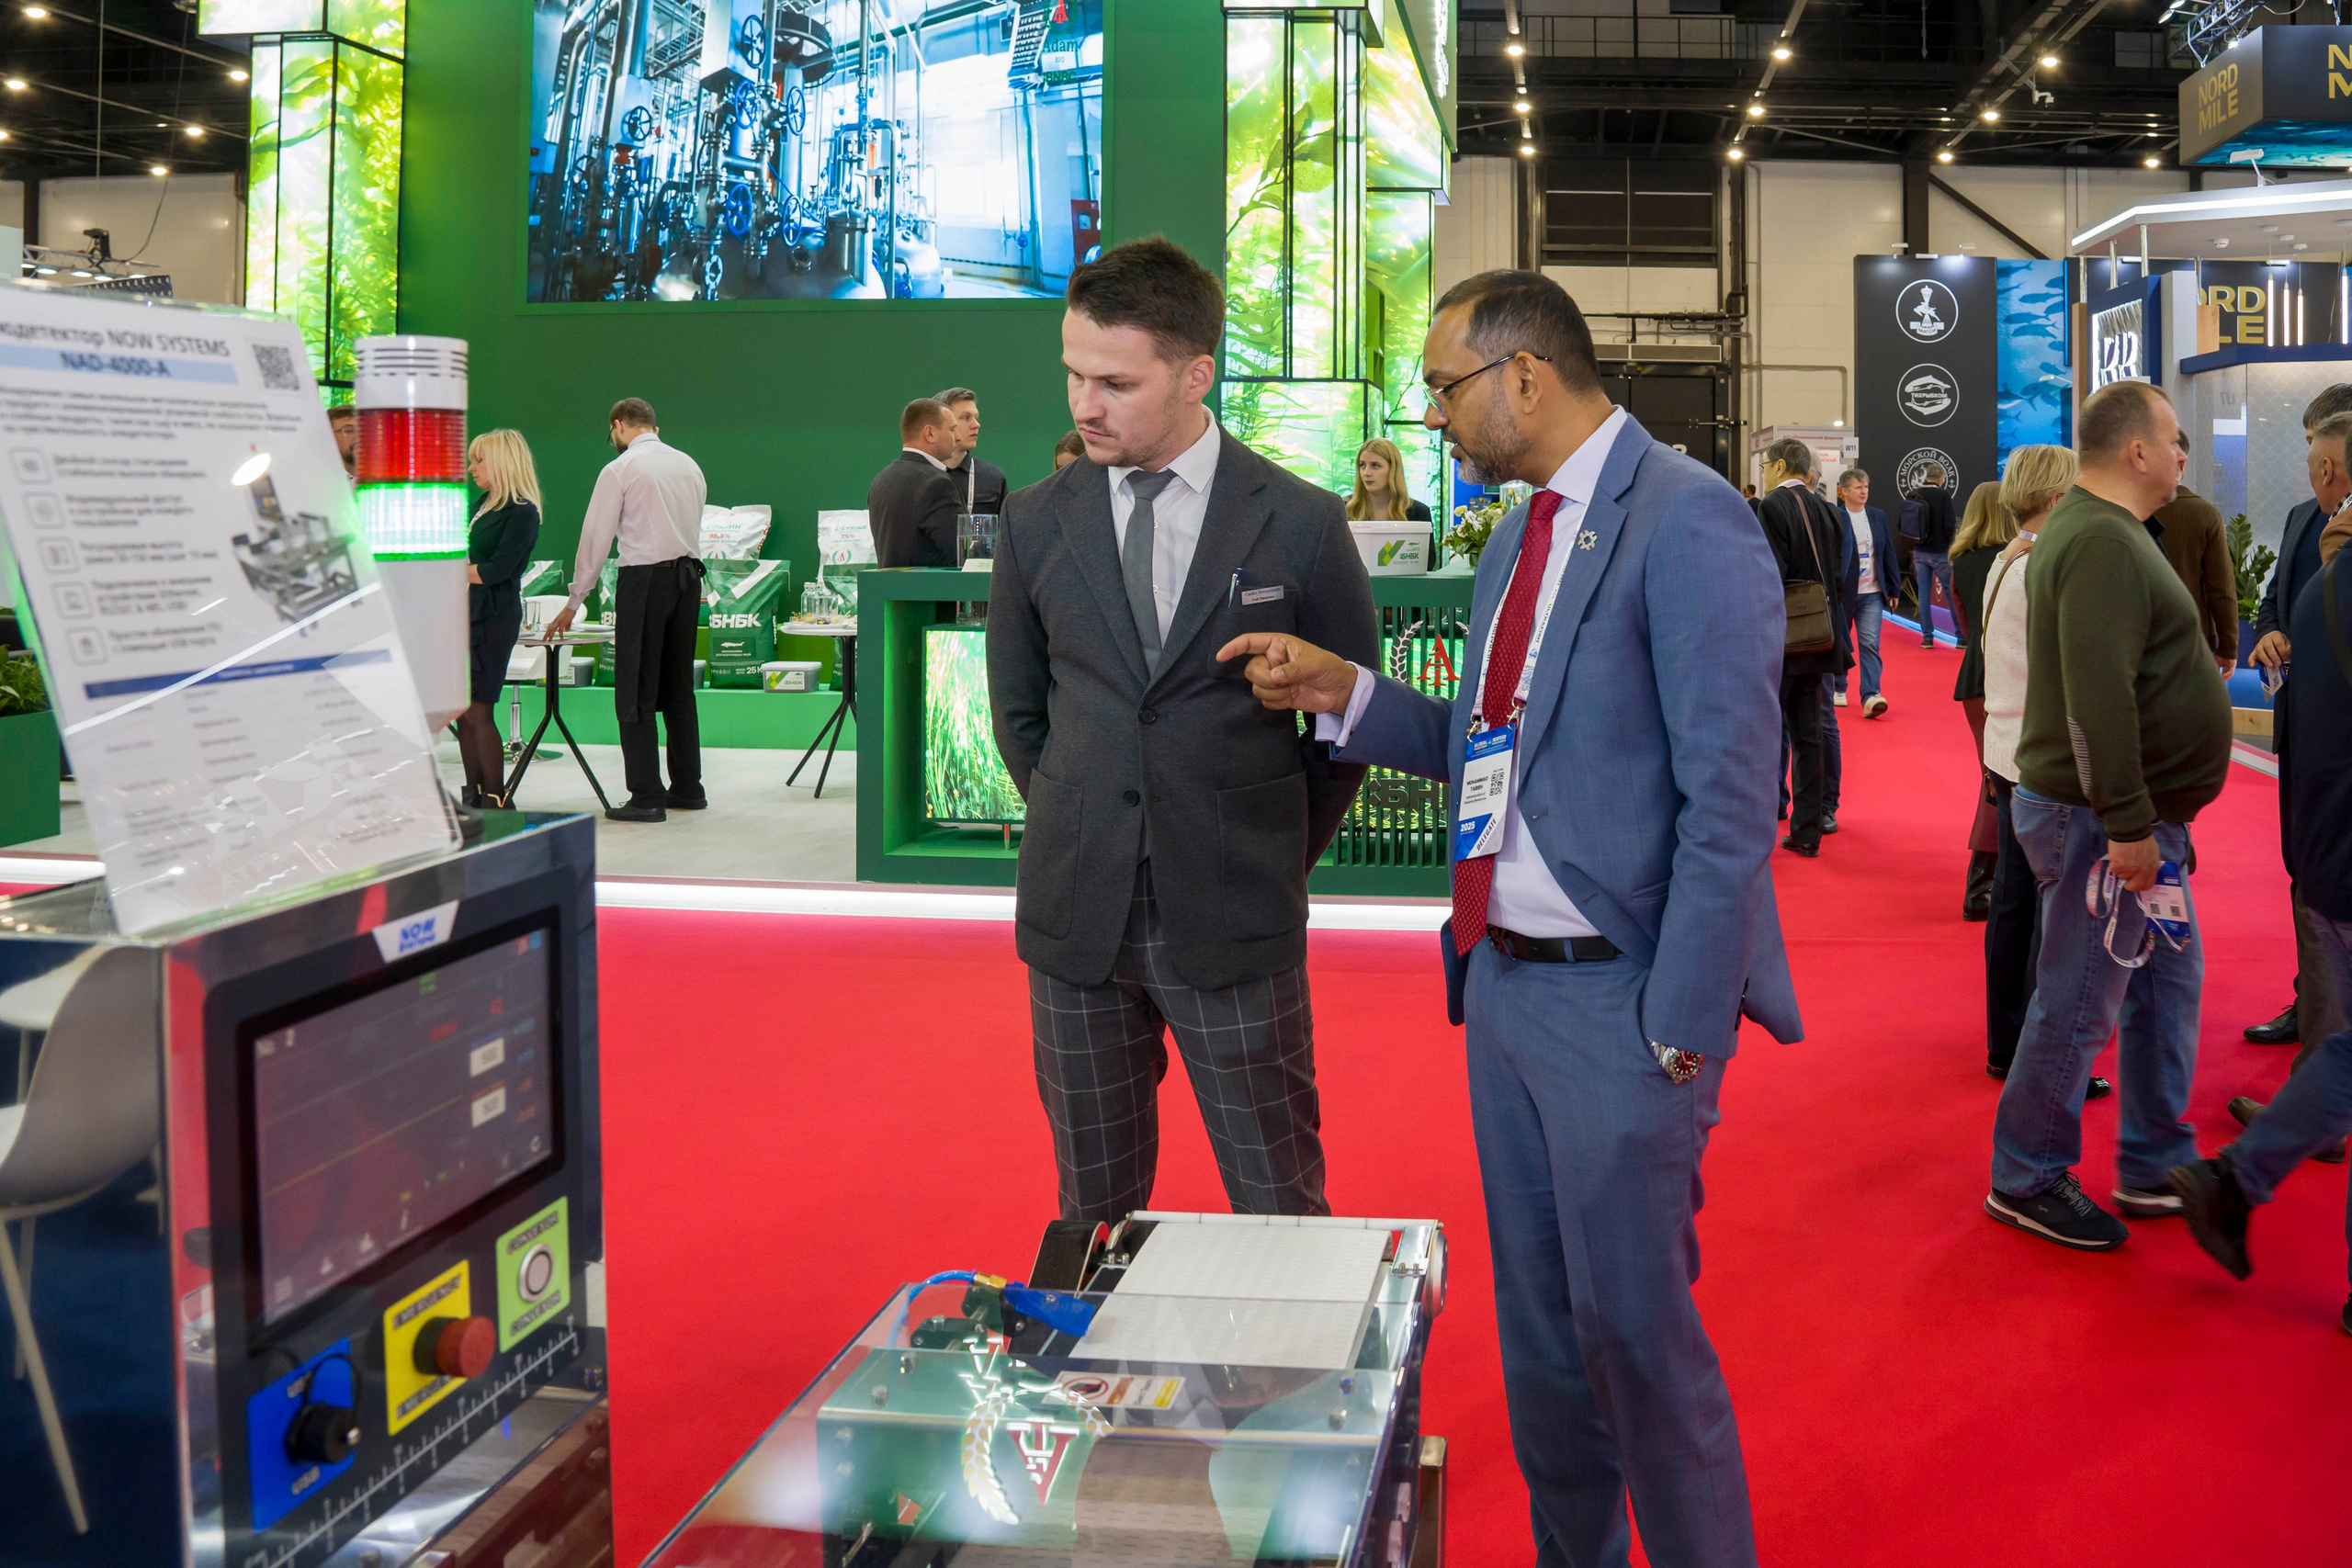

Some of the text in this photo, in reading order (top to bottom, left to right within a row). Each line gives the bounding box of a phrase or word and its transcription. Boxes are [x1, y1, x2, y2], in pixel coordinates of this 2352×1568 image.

[1042, 39, 1078, 52] Adam
[2199, 63, 2238, 108] NORD
[2199, 88, 2238, 135] MILE
[2201, 286, 2266, 313] RD
[107, 329, 153, 349] NOW
[157, 334, 230, 356] SYSTEMS
[1901, 450, 1955, 477] МОРСКОЙ ВОЛК
[1476, 818, 1497, 851] DELEGATE
[401, 917, 436, 941] NOW
